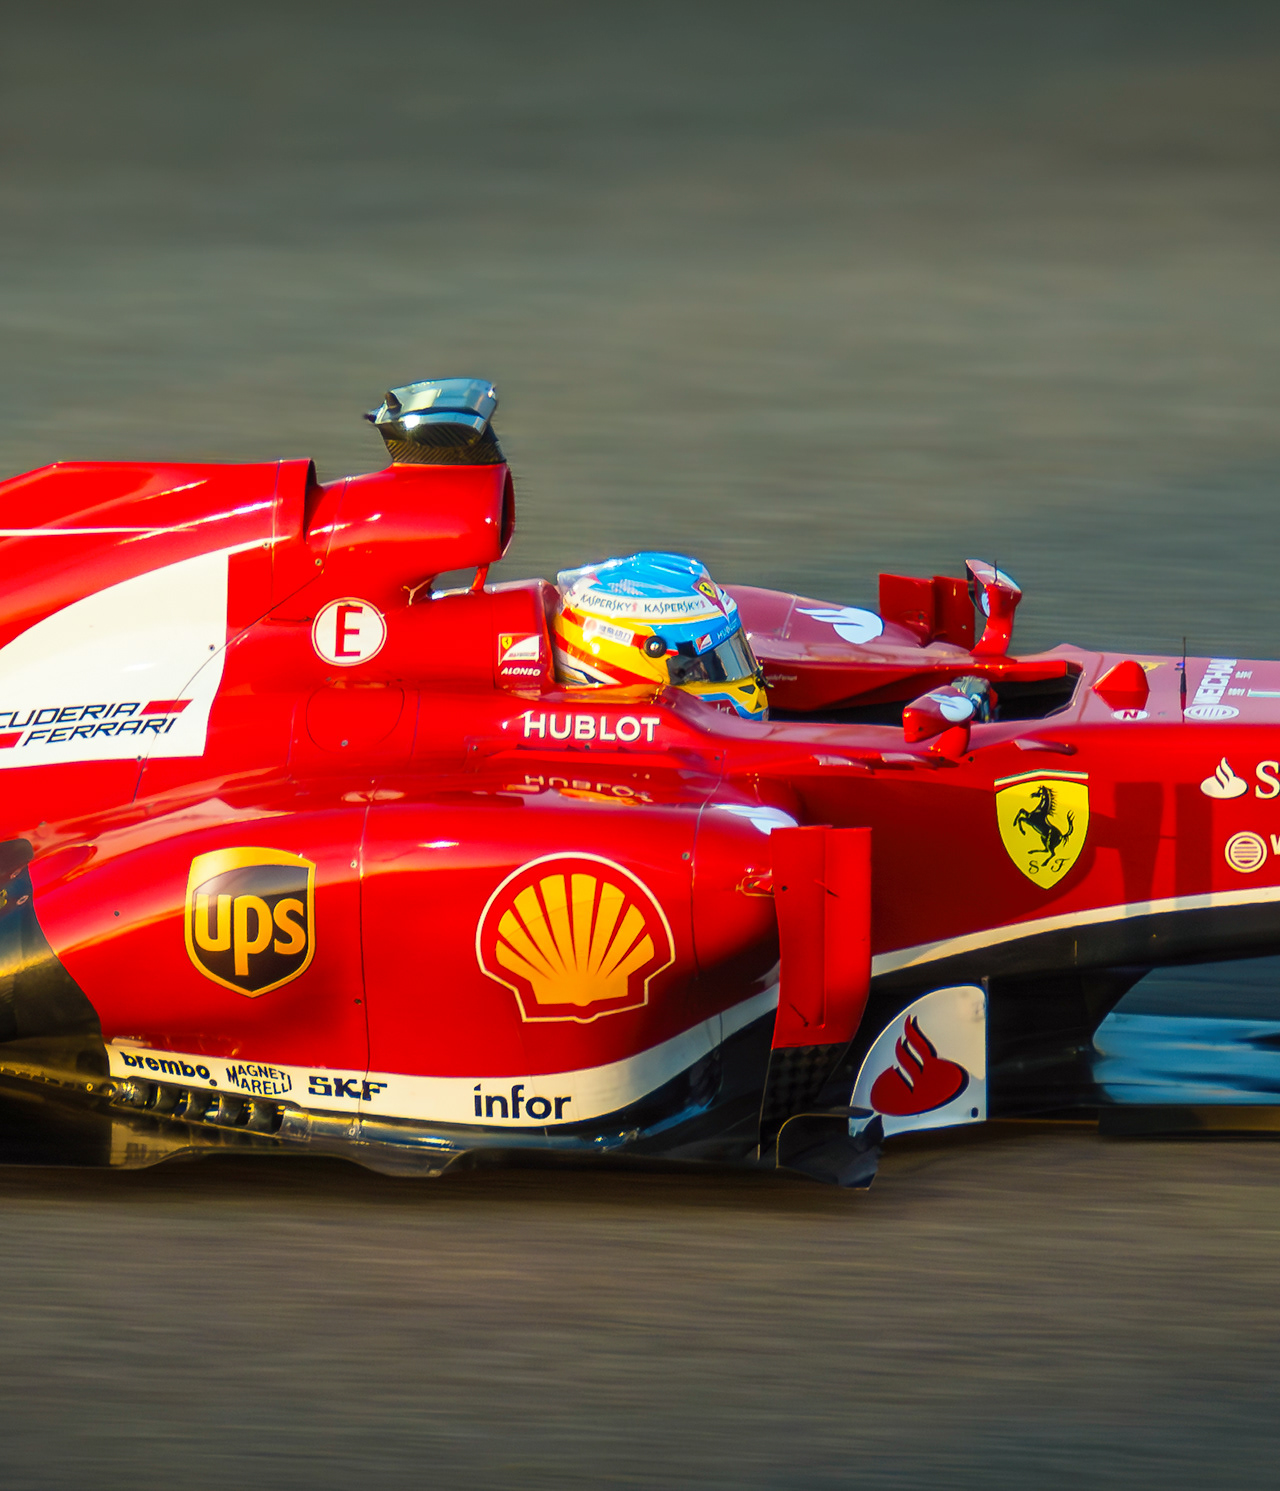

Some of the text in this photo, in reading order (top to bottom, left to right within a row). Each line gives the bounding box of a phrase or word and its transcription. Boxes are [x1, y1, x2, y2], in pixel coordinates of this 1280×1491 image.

[644, 600, 700, 614] KASPERSKY
[334, 605, 364, 657] E
[501, 667, 541, 676] ALONSO
[22, 717, 178, 747] FERRARI
[523, 712, 660, 743] HUBLOT
[194, 893, 307, 976] ups
[120, 1051, 210, 1080] brembo
[308, 1076, 387, 1101] SKF
[474, 1084, 573, 1120] infor
